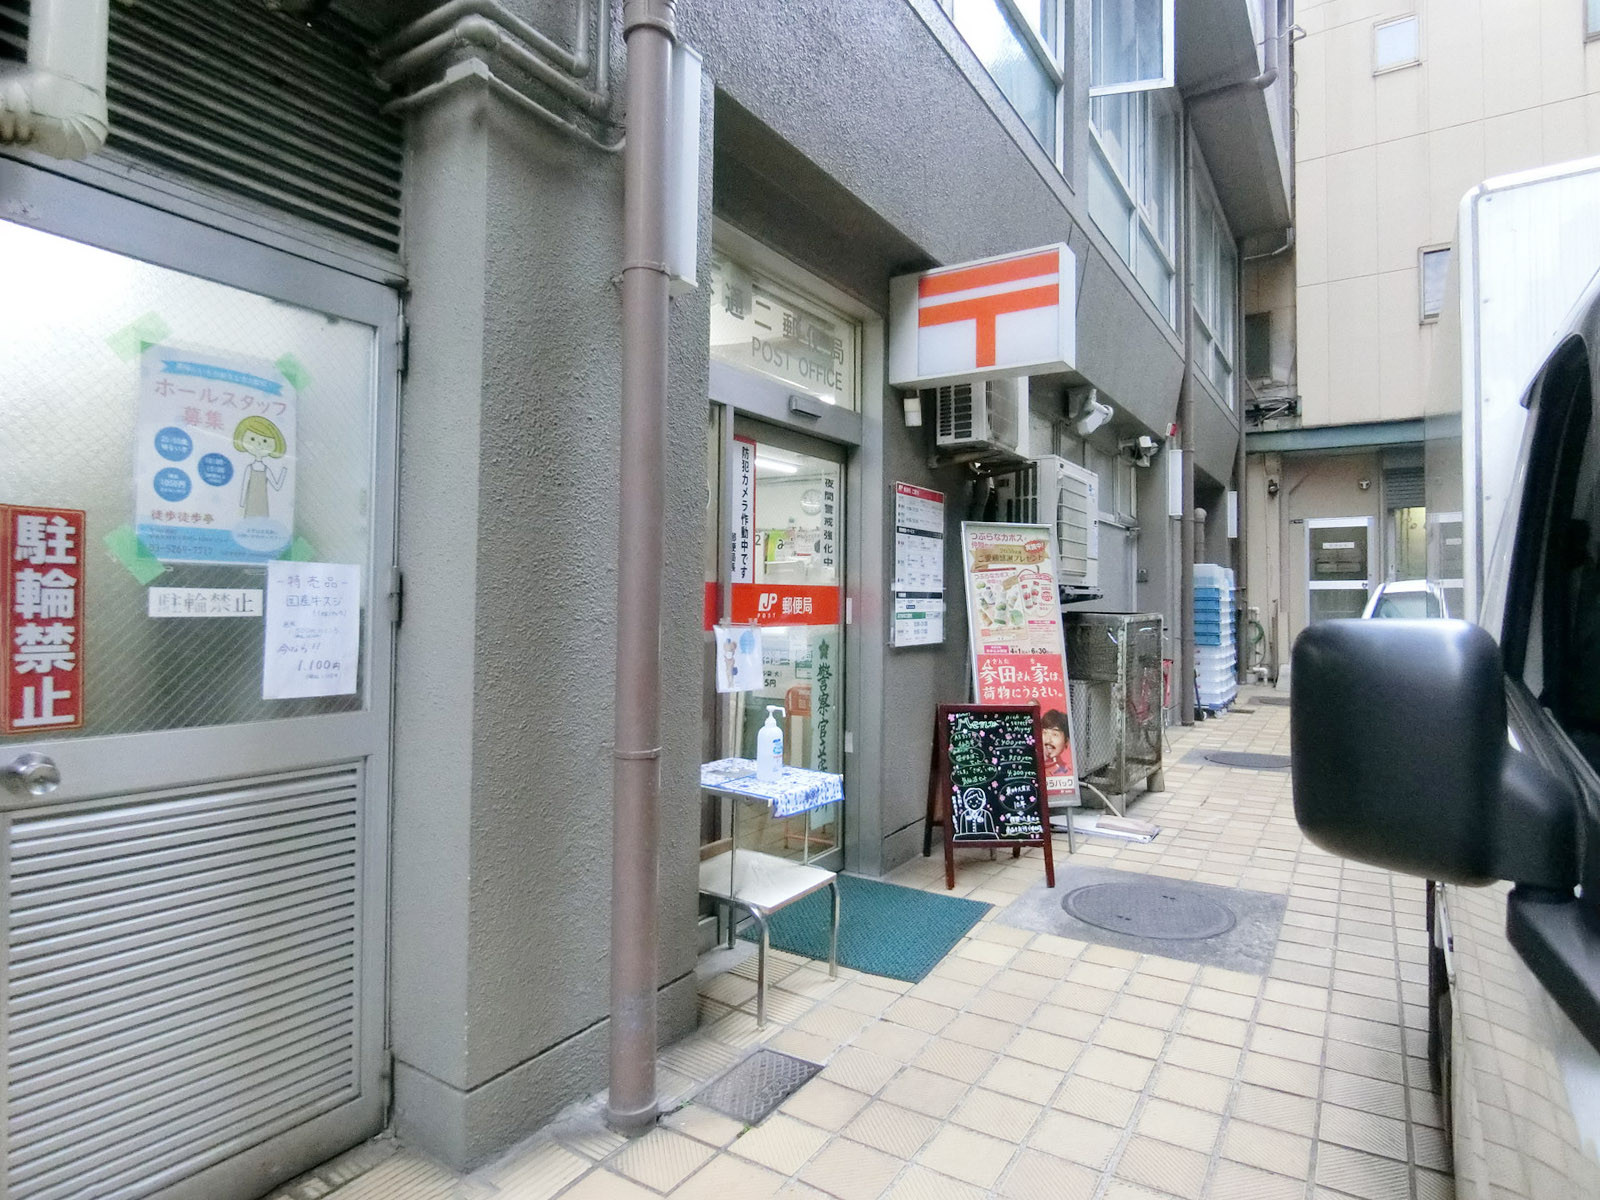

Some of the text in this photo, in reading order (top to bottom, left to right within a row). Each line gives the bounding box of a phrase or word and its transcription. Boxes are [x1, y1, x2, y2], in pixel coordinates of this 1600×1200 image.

[751, 336, 843, 391] POST OFFICE
[154, 378, 288, 416] ホールスタッフ
[183, 405, 225, 431] 募集
[741, 446, 750, 579] 防犯カメラ作動中です
[824, 478, 834, 567] 夜間警戒強化中
[970, 533, 1024, 542] つぶらなカボス
[158, 592, 254, 613] 駐輪禁止
[287, 595, 342, 607] 国産牛スジ
[782, 597, 813, 615] 郵便局
[13, 515, 77, 727] 駐輪禁止
[983, 686, 1063, 700] 荷物にうるさい。
